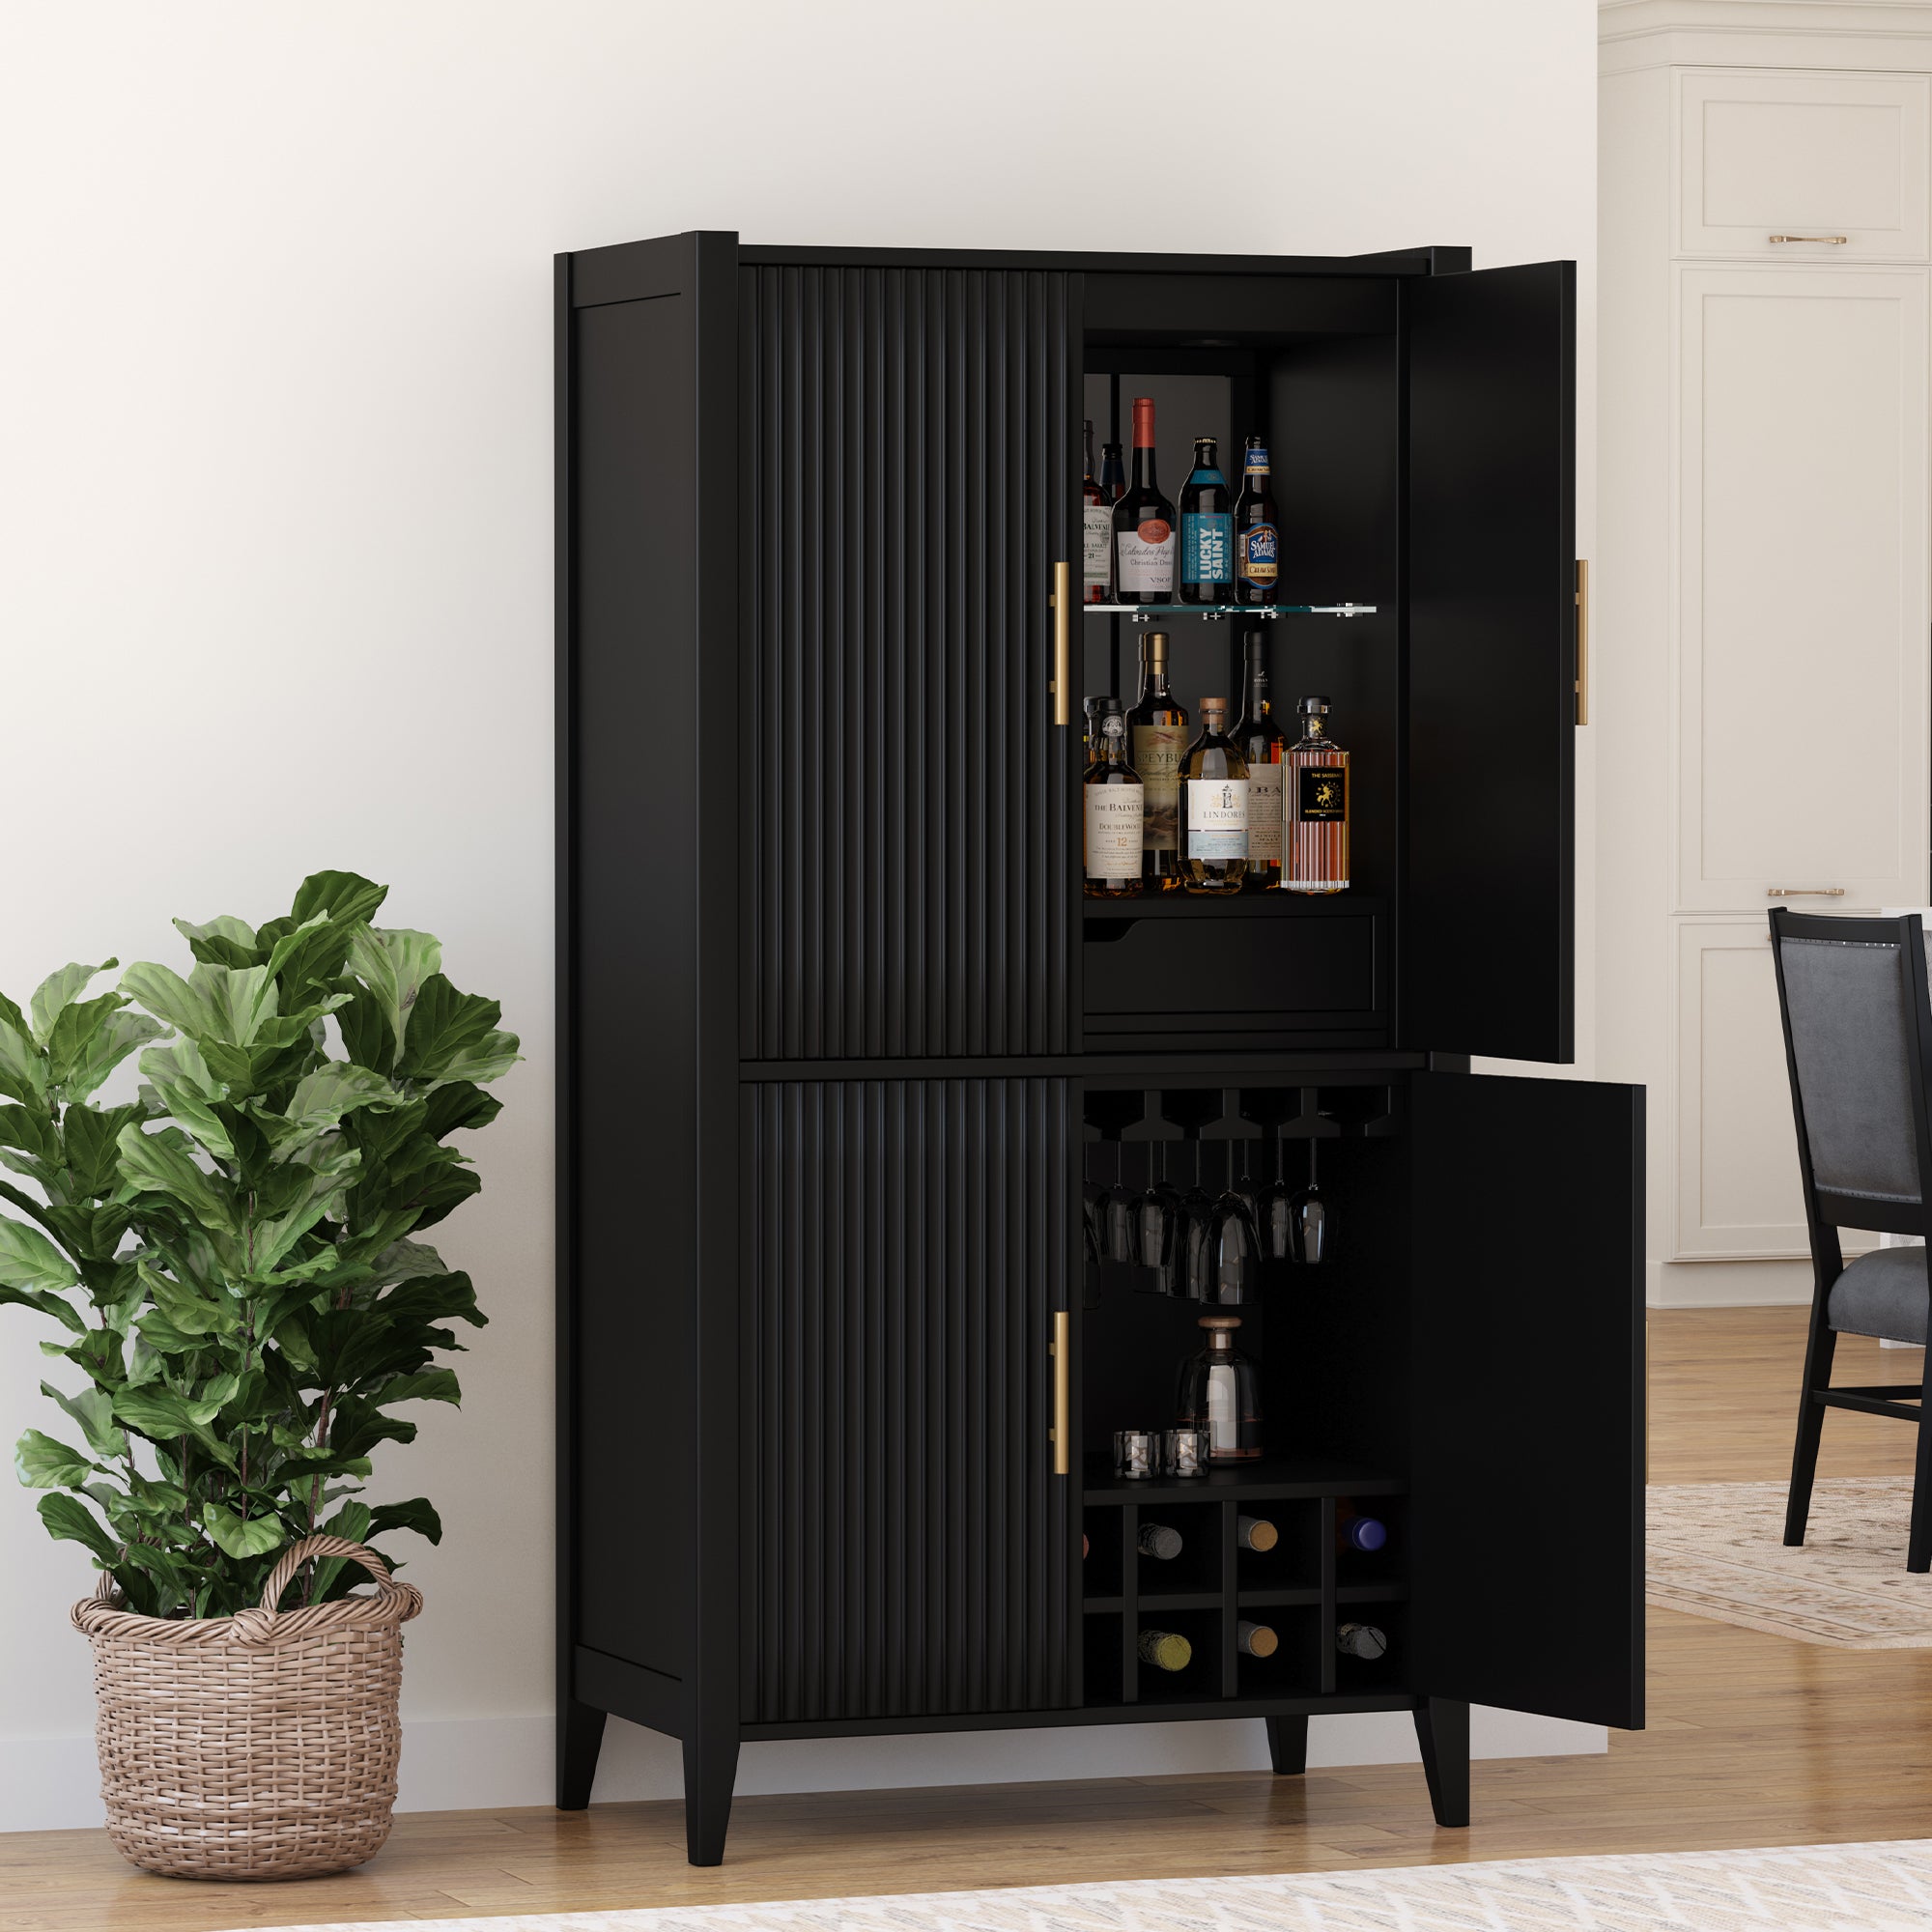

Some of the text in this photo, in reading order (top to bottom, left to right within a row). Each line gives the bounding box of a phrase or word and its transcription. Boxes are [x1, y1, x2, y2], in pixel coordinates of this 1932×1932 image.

[1250, 540, 1276, 551] SAMUEL
[1200, 527, 1212, 580] LUCKY
[1211, 527, 1224, 580] SAINT
[1252, 549, 1275, 558] ADAMS
[1203, 810, 1246, 819] LINDORES
[1117, 837, 1128, 847] 12
